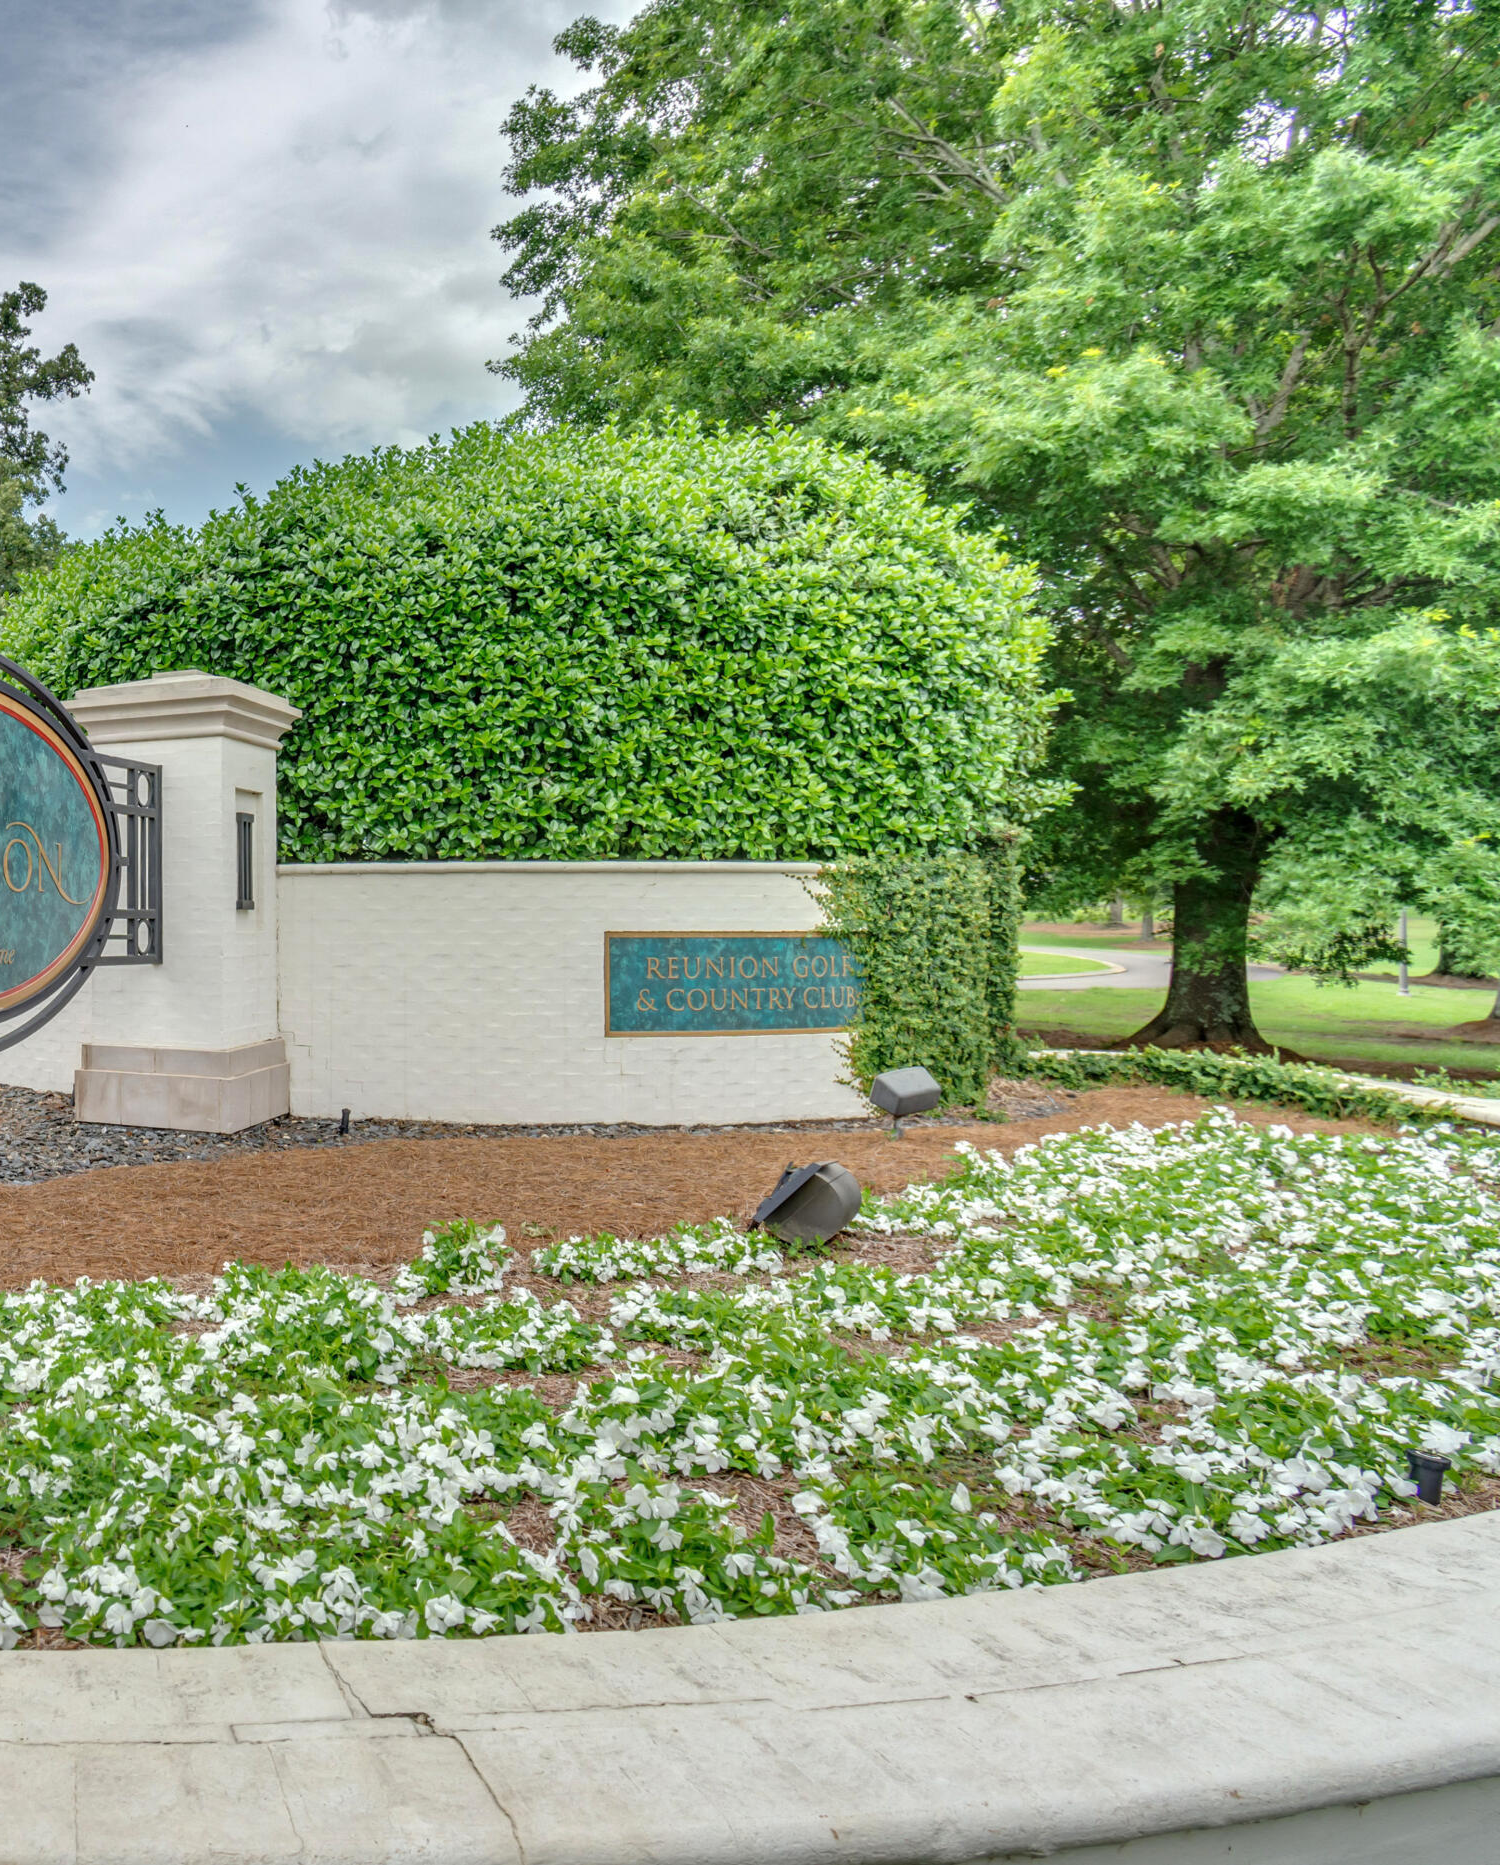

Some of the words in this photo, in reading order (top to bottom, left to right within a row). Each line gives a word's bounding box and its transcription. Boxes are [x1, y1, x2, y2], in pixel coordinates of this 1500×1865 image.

[646, 956, 779, 979] REUNION
[792, 955, 851, 978] GOLF
[636, 989, 658, 1012] &
[666, 987, 796, 1012] COUNTRY
[803, 986, 857, 1009] CLUB
